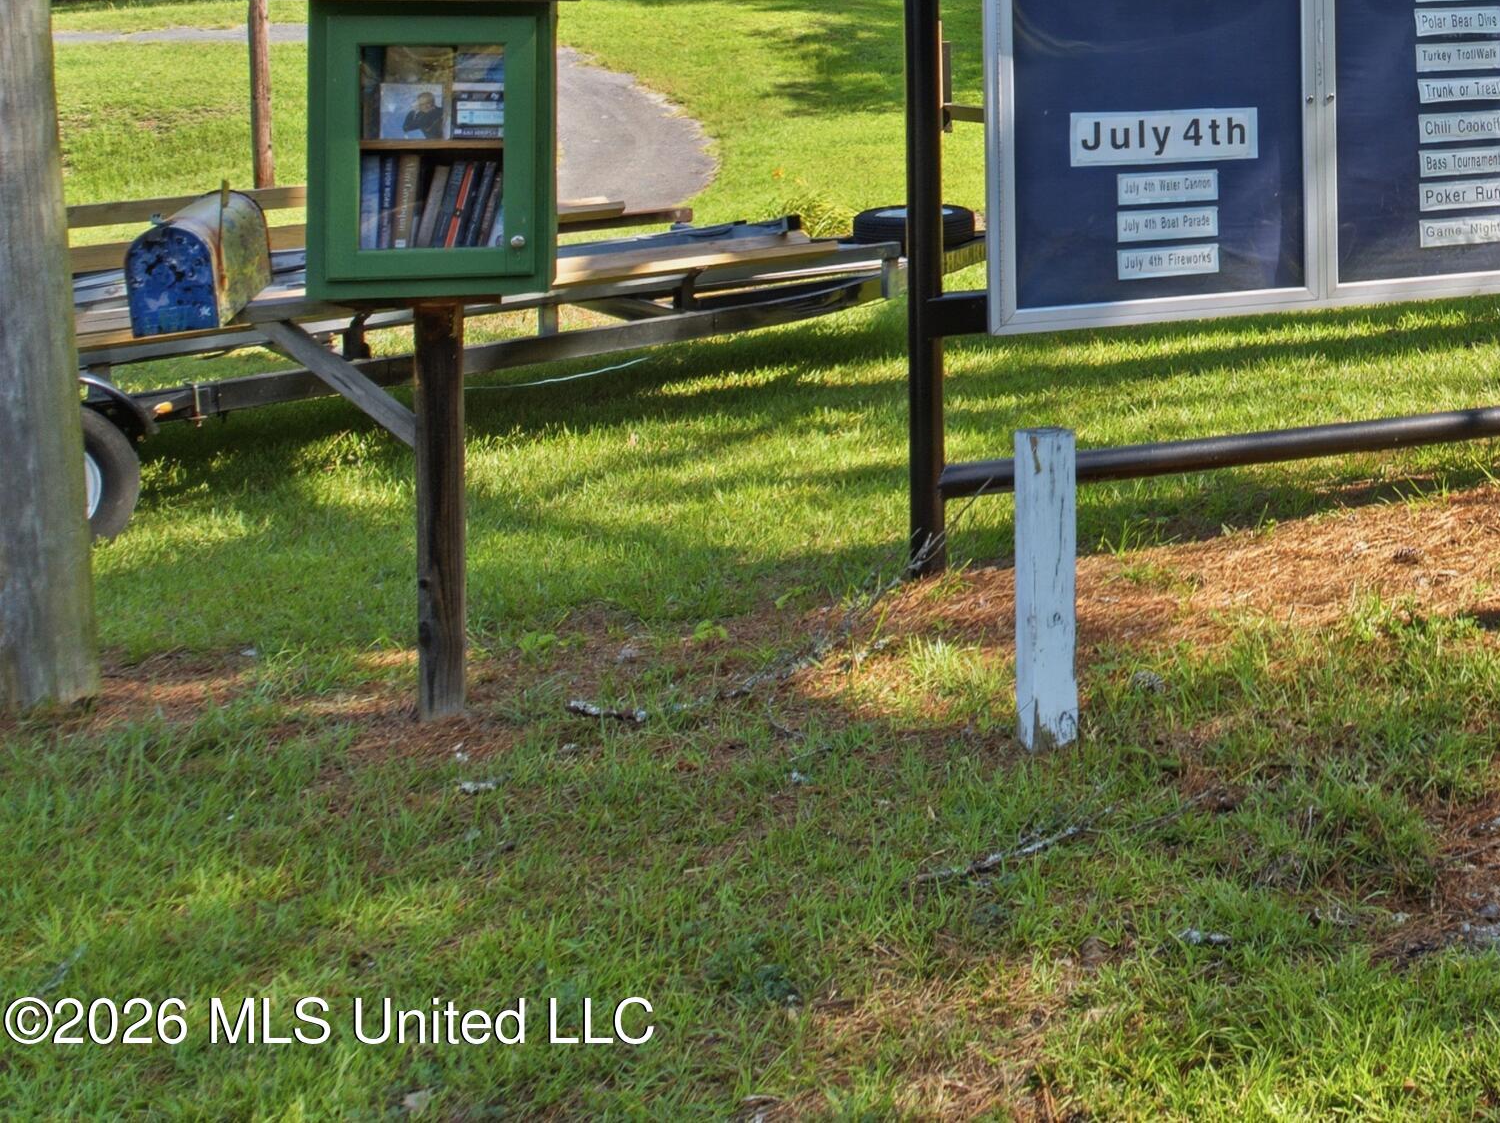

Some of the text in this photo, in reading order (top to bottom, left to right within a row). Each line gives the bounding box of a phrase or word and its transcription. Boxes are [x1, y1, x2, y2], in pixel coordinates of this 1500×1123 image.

[1421, 14, 1447, 29] Polar
[1450, 13, 1473, 28] Bear
[1422, 49, 1452, 64] Turkey
[1425, 83, 1455, 98] Trunk
[1459, 85, 1470, 97] or
[1424, 119, 1451, 136] Chili
[1081, 117, 1247, 156] July 4th
[1425, 152, 1500, 171] Bass Tournament
[1124, 177, 1212, 196] July 4th Water Cannon
[1425, 188, 1467, 205] Poker
[1123, 214, 1211, 234] July 4th Boat Parade
[1425, 222, 1500, 238] Game Night
[1124, 252, 1213, 272] July 4th Fireworks
